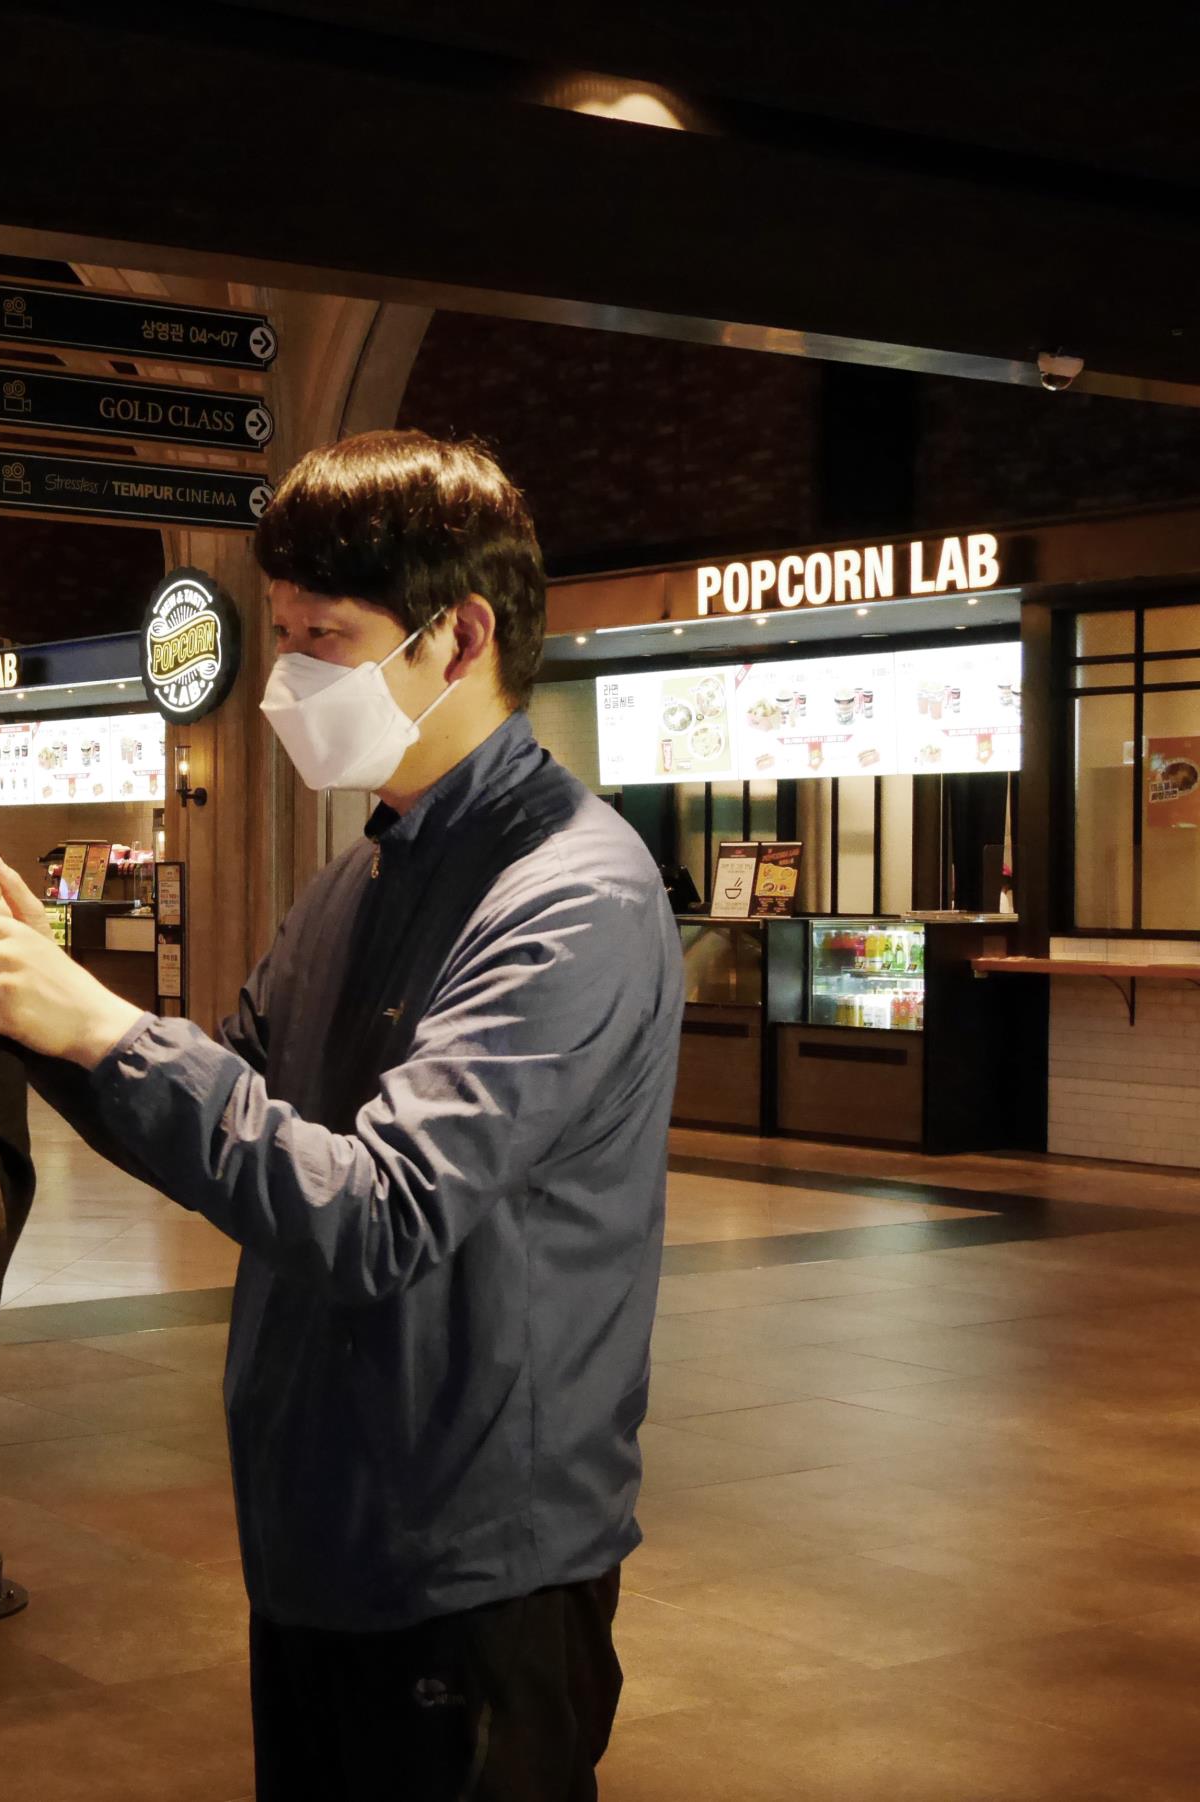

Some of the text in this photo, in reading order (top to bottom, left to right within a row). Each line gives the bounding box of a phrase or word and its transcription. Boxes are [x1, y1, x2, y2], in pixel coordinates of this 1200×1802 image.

[141, 319, 239, 348] 상영관 04~07
[100, 397, 235, 432] GOLD CLASS
[44, 474, 99, 495] Stressless
[112, 481, 174, 500] TEMPUR
[176, 487, 237, 507] CINEMA
[697, 533, 1000, 616] POPCORN LAB
[183, 588, 207, 611] TASTY
[152, 621, 215, 673] POPCORN
[168, 680, 201, 706] LAB
